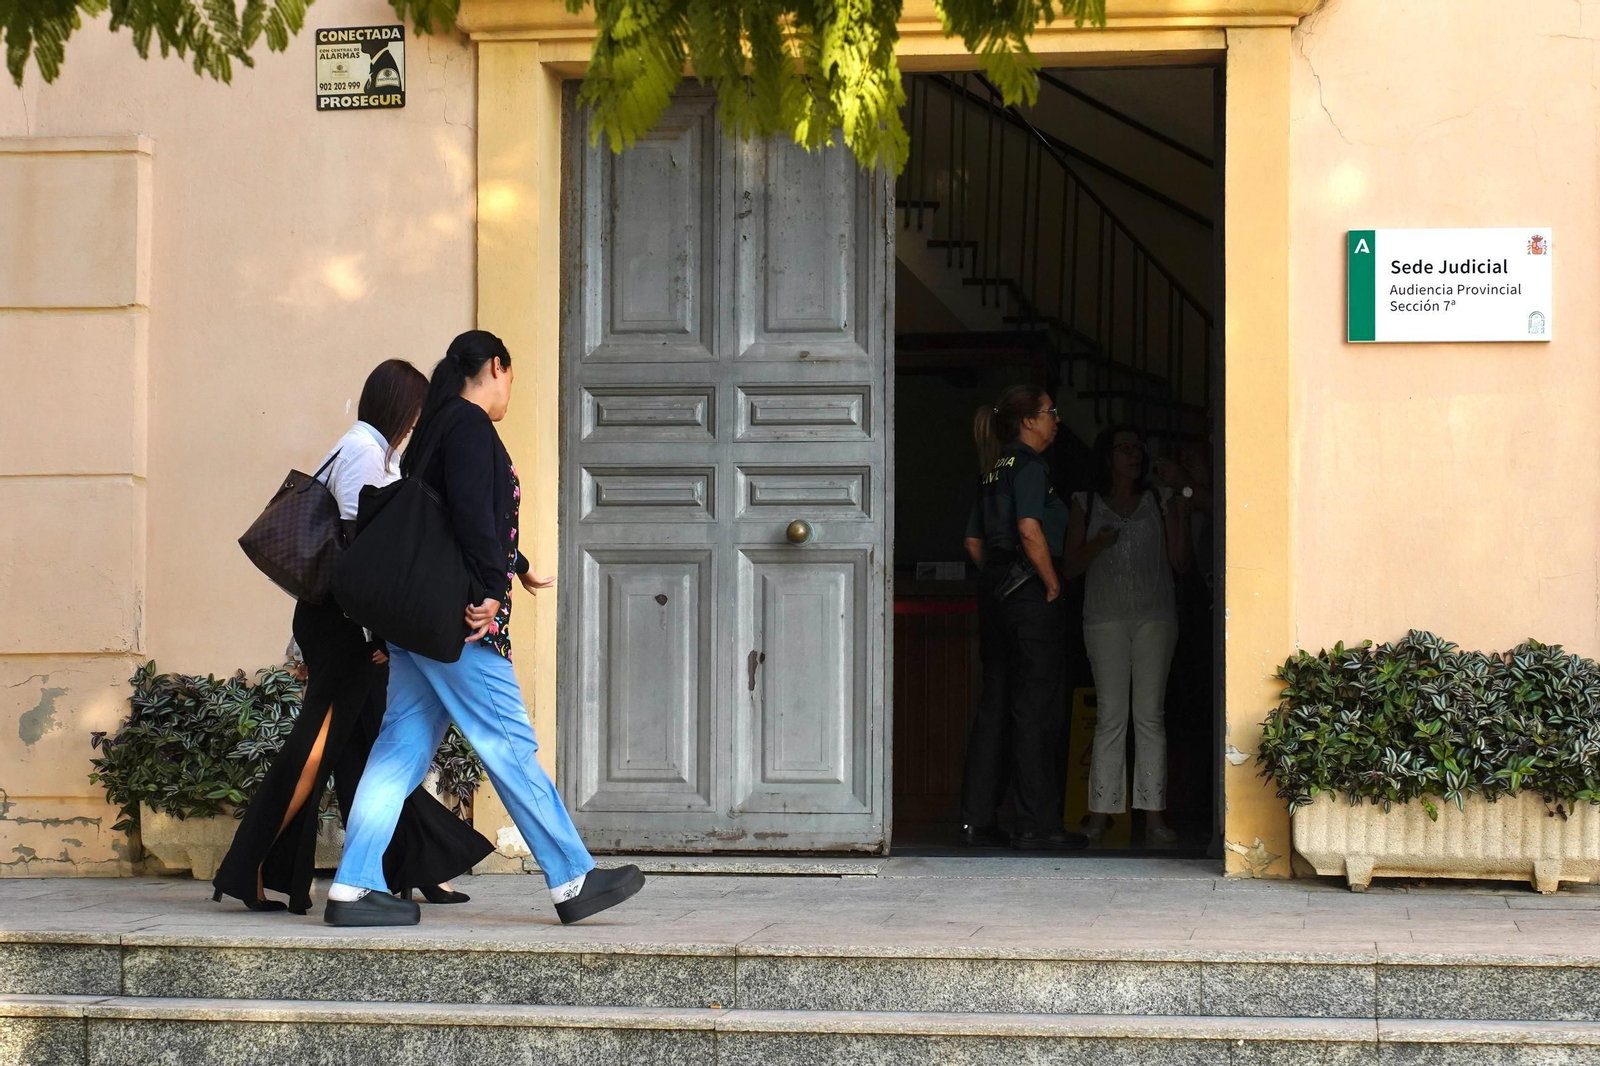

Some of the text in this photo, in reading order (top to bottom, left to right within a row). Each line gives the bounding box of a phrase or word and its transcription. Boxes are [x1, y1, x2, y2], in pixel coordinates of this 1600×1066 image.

[319, 27, 401, 42] CONECTADA
[319, 52, 360, 60] ALARMAS
[319, 81, 361, 91] 902 202 999
[320, 94, 402, 108] PROSEGUR
[1391, 259, 1508, 274] Sede Judicial
[1389, 283, 1522, 296] Audiencia Provincial
[1390, 299, 1456, 312] Sección 7ª
